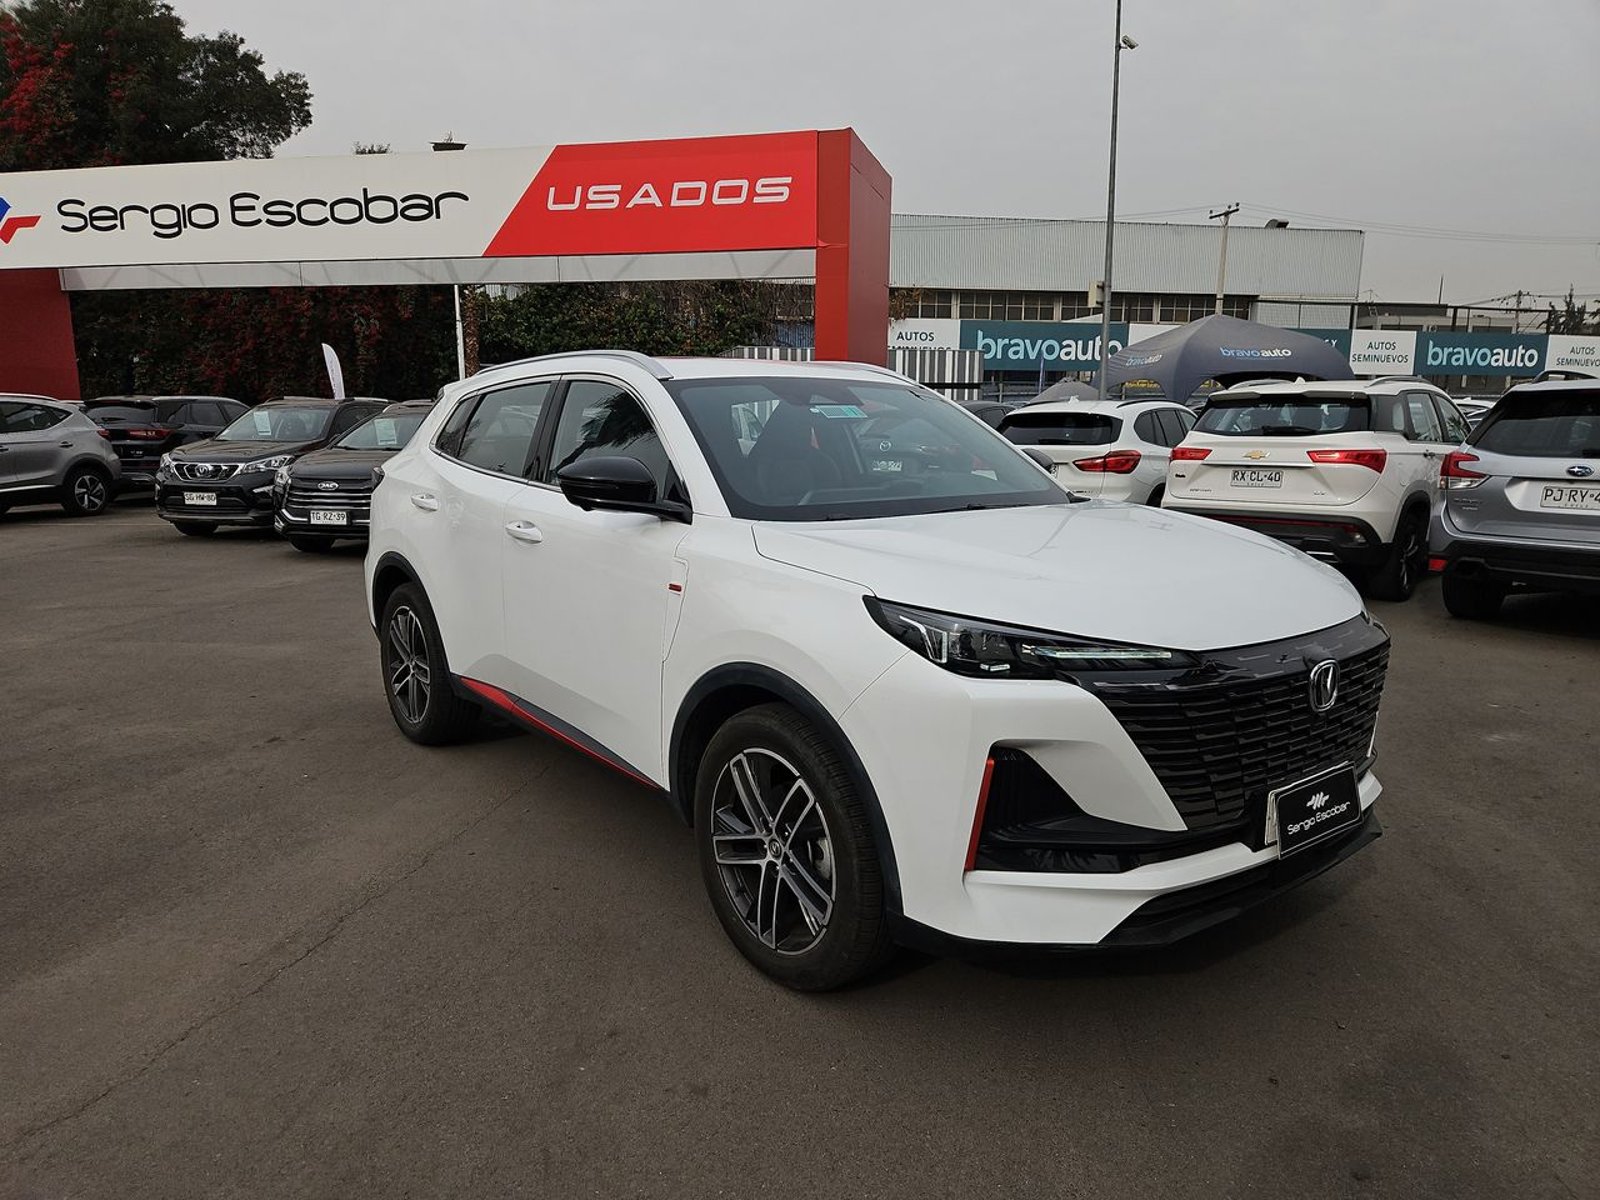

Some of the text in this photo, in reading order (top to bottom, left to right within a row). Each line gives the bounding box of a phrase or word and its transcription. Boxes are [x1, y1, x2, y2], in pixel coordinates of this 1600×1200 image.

[547, 177, 792, 211] USADOS
[57, 188, 469, 238] Sergio Escobar
[896, 331, 935, 342] AUTOS
[977, 330, 1122, 361] bravoauto
[1219, 346, 1292, 357] bravoauto
[1367, 341, 1397, 351] AUTOS
[1427, 340, 1539, 367] bravoauto
[1570, 346, 1596, 356] AUTOS
[1352, 353, 1409, 363] SEMINUEVOS
[1316, 801, 1350, 822] Escobar
